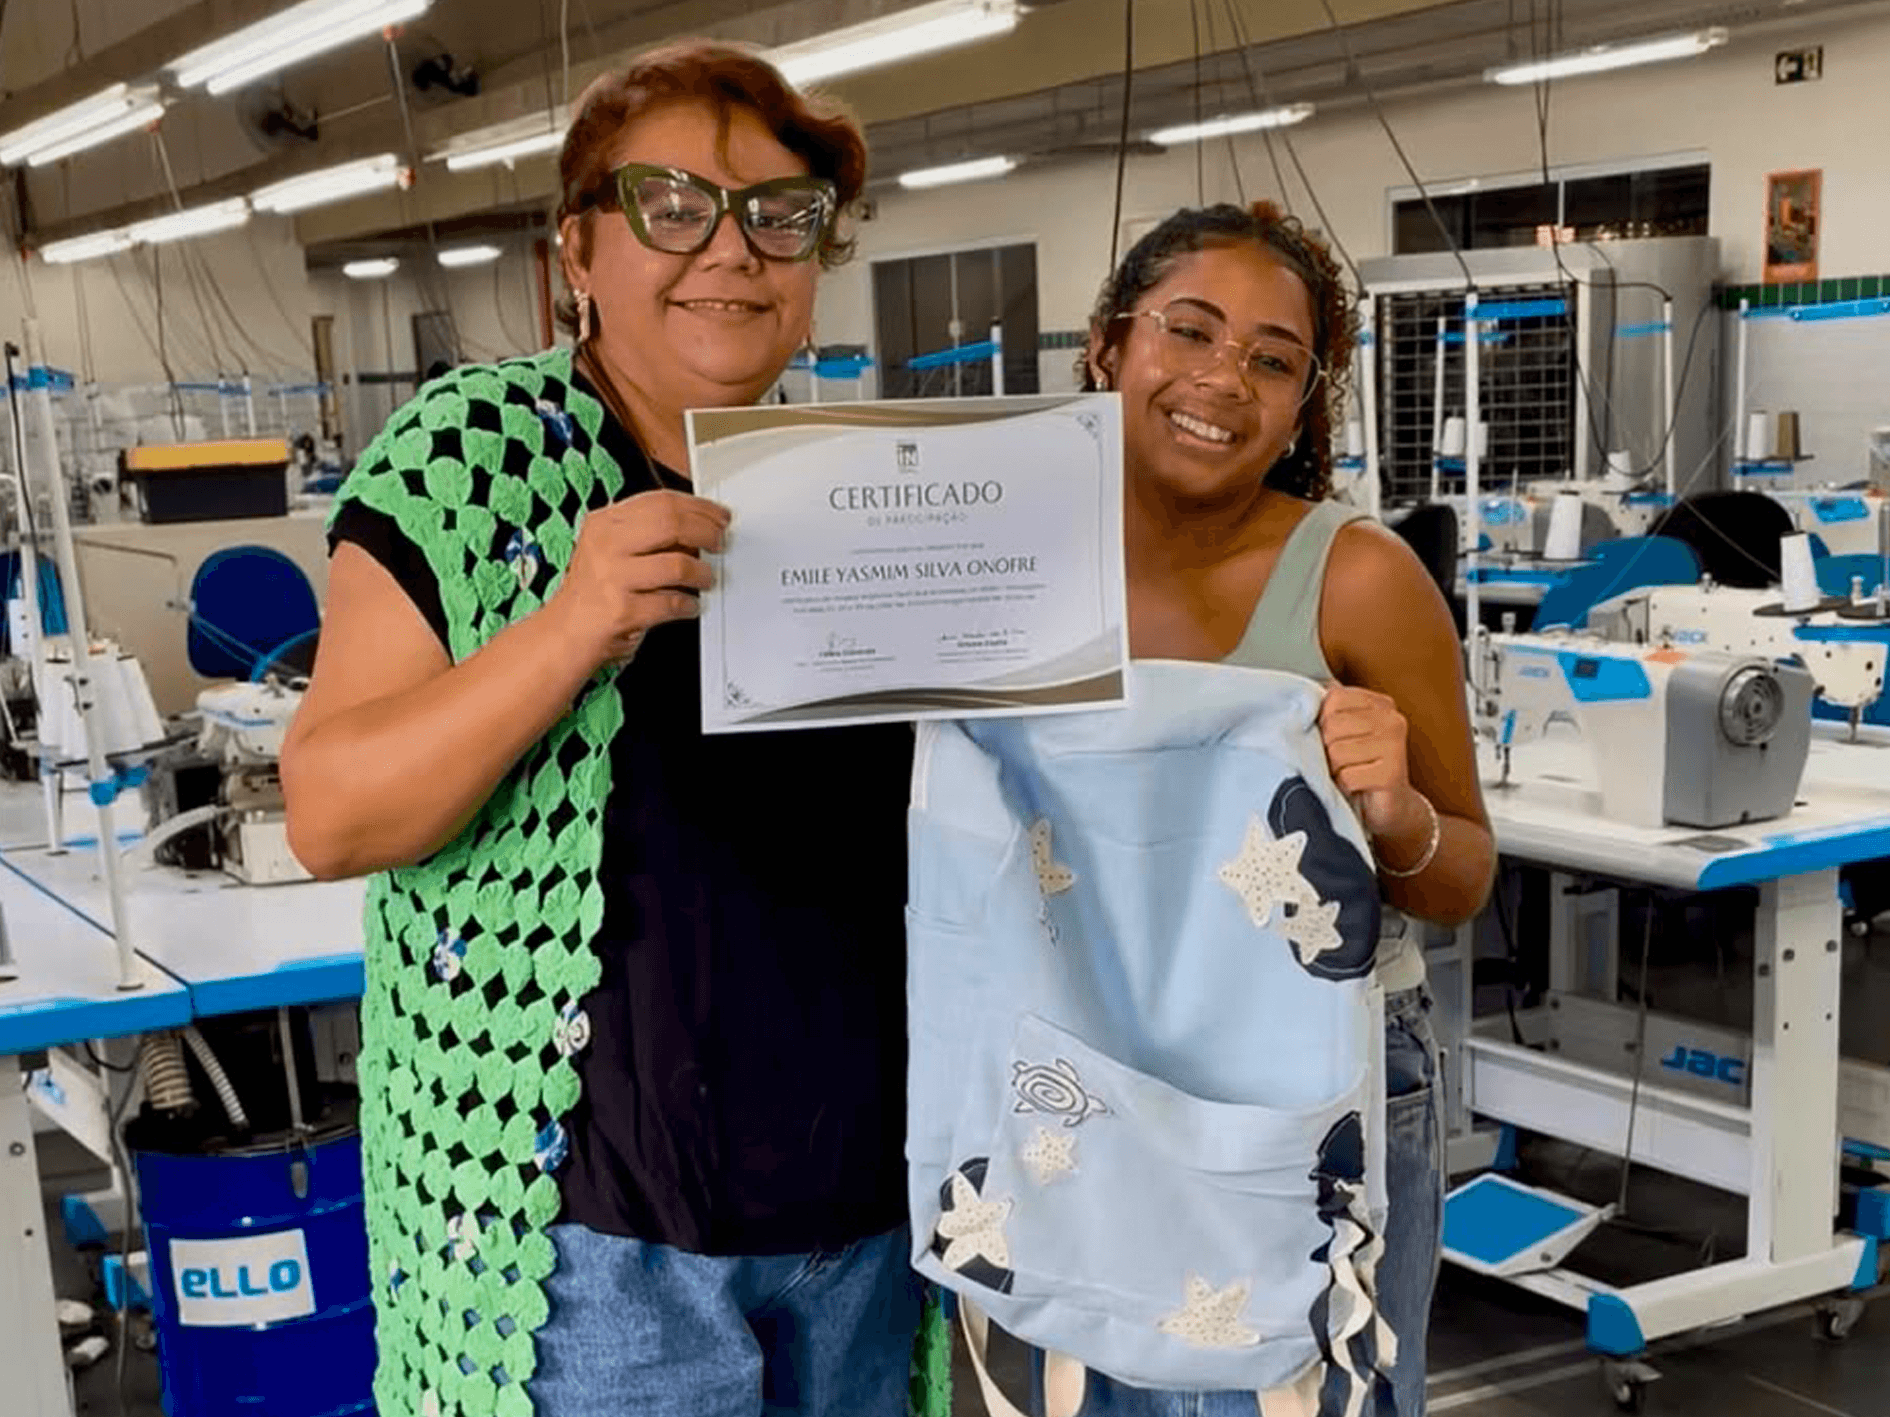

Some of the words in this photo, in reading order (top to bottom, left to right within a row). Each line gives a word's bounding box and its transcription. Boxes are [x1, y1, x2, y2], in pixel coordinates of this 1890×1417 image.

[829, 480, 1003, 510] CERTIFICADO
[781, 567, 831, 586] EMILE
[836, 564, 909, 583] YASMIM
[915, 561, 962, 579] SILVA
[966, 556, 1036, 576] ONOFRE
